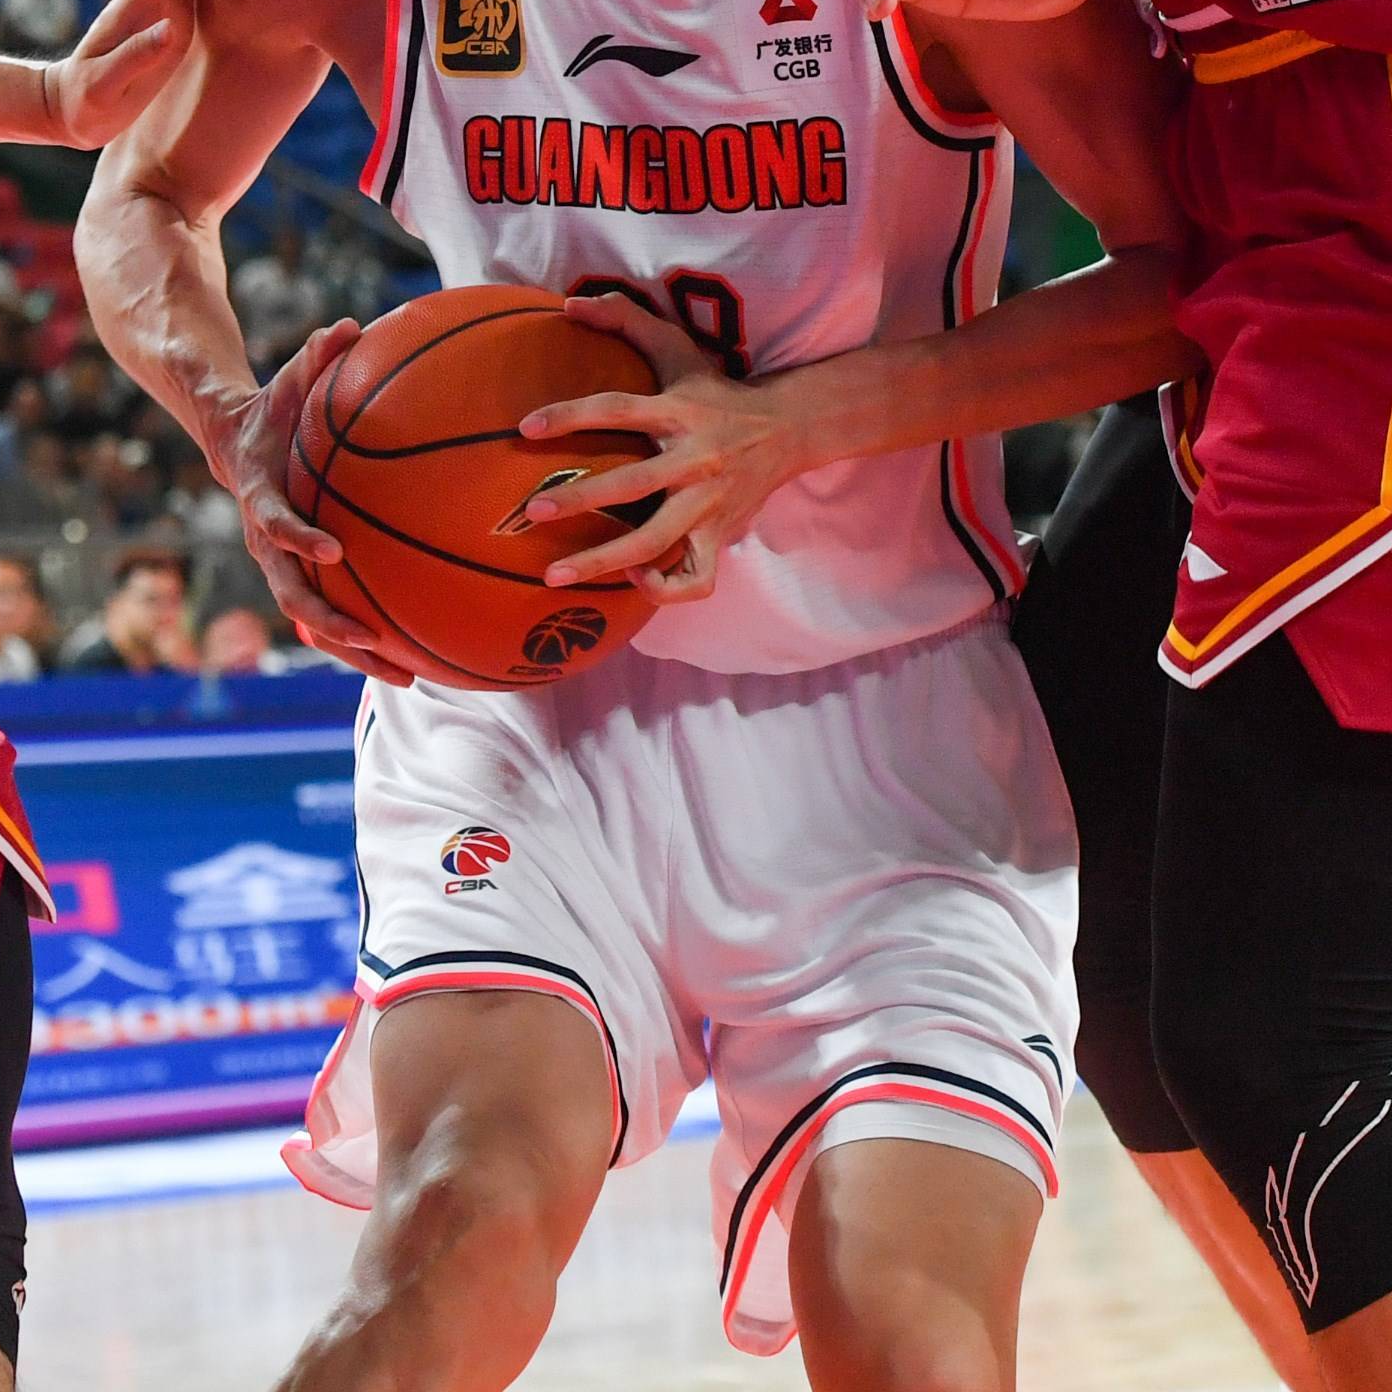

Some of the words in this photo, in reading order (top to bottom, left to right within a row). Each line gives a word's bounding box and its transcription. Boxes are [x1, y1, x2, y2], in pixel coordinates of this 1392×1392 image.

[466, 40, 510, 56] CBA
[756, 34, 833, 60] 广发银行
[773, 59, 821, 81] CGB
[463, 114, 848, 215] GUANGDONG
[566, 268, 752, 381] 8
[444, 878, 499, 895] CBA
